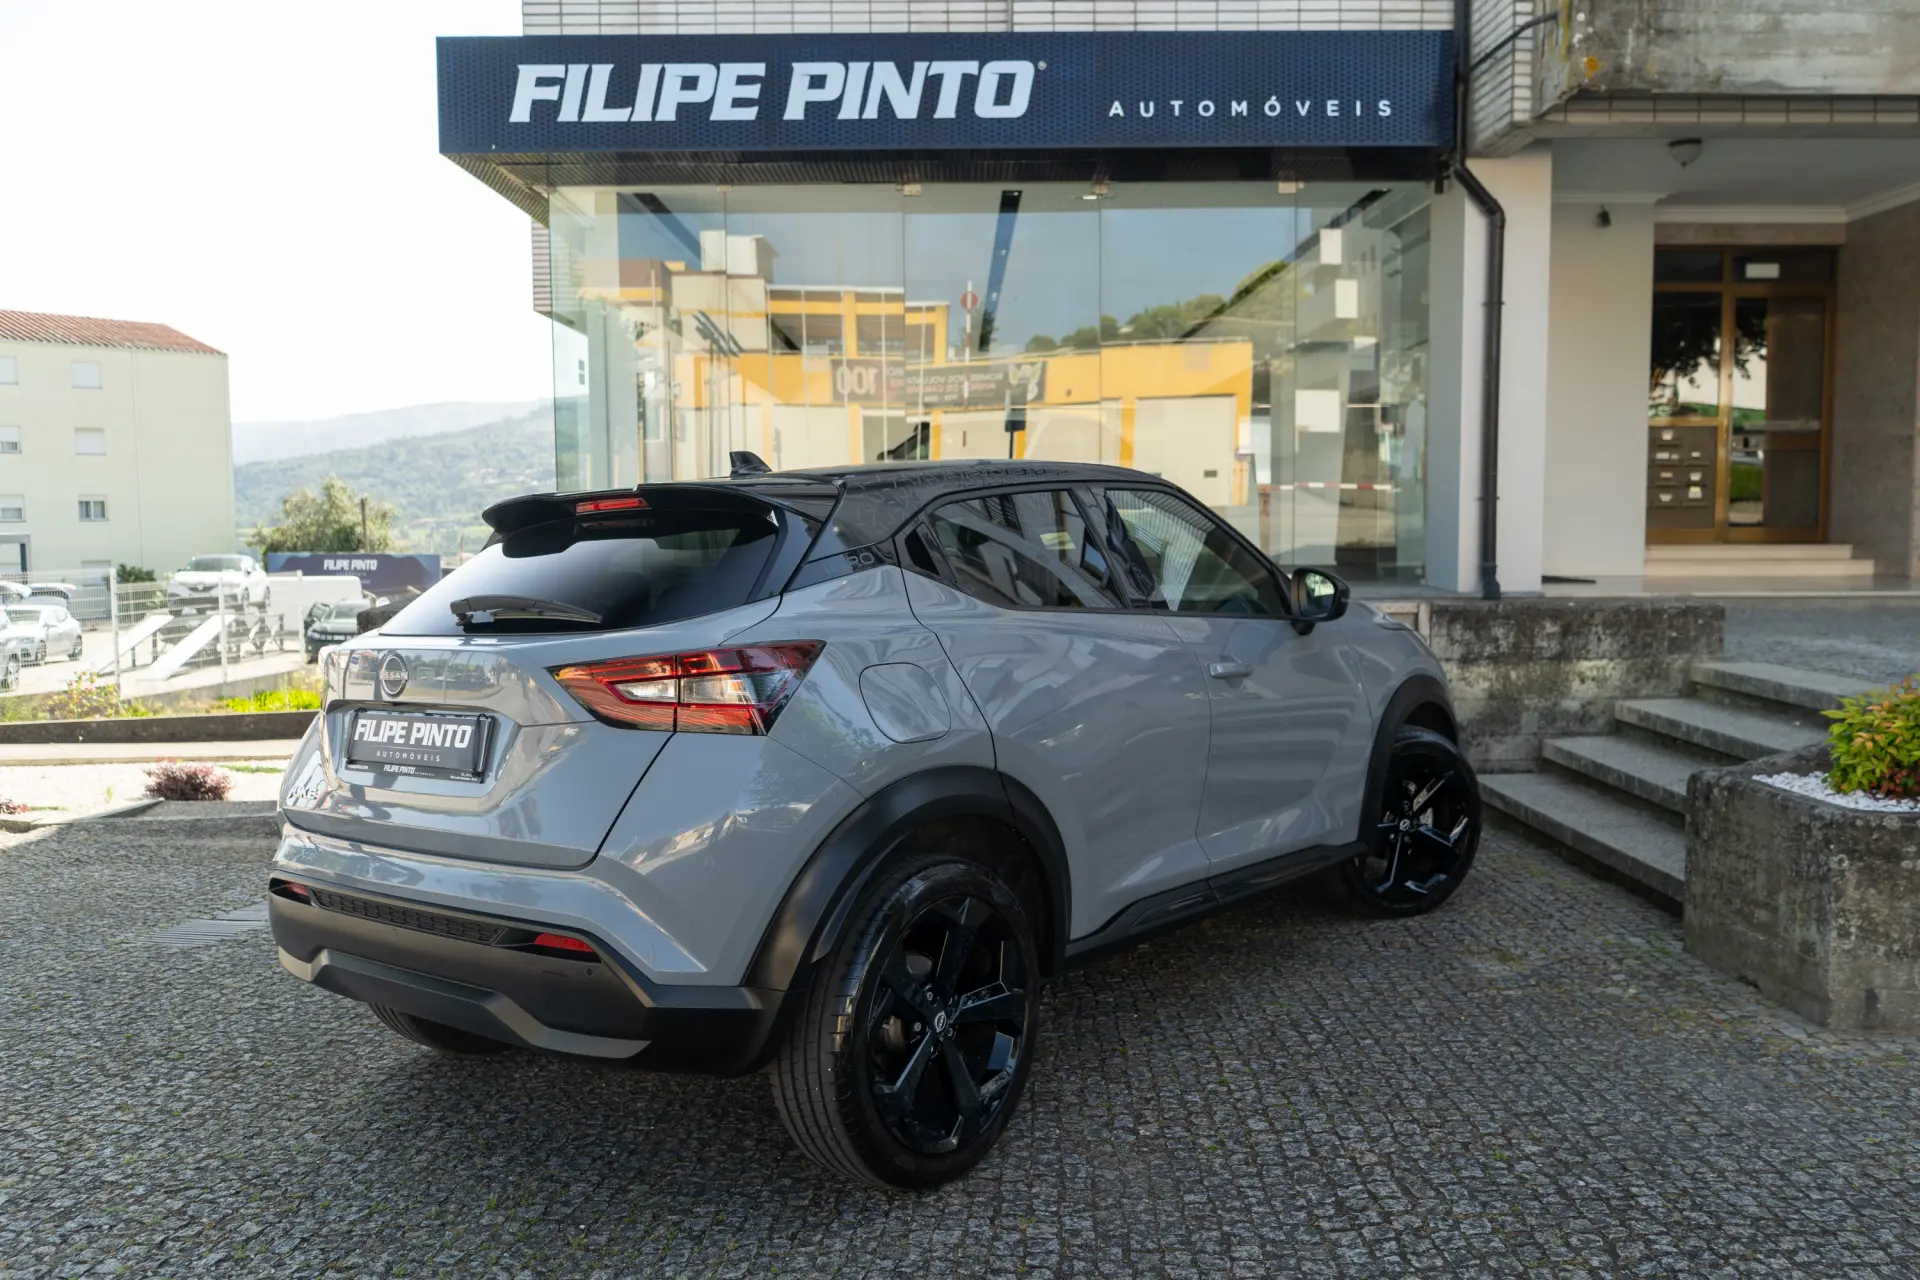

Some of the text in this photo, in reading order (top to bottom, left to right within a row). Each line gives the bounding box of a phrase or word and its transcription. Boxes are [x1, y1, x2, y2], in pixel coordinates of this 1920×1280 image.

[509, 60, 1035, 122] FILIPE PINTO
[1108, 95, 1392, 118] AUTOMÓVEIS
[323, 559, 378, 571] FILIPE PINTO
[354, 719, 472, 748] FILIPE PINTO
[376, 750, 440, 762] AUTOMÓVEIS
[383, 764, 399, 773] FILIPE
[399, 766, 416, 775] PINTO
